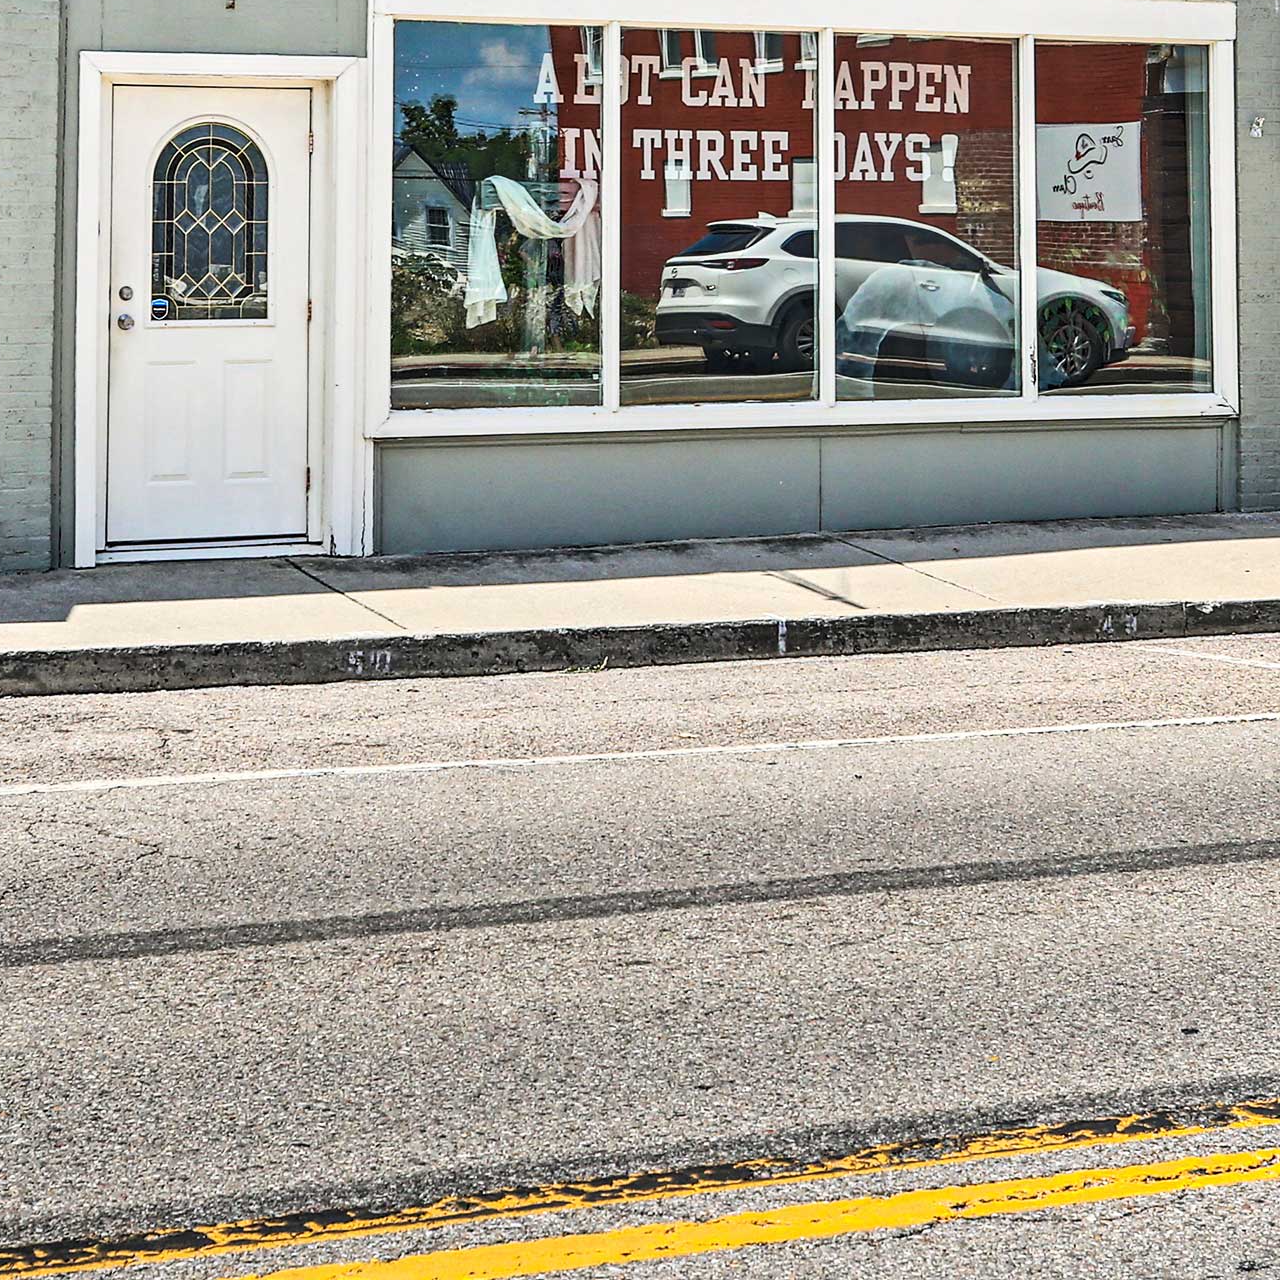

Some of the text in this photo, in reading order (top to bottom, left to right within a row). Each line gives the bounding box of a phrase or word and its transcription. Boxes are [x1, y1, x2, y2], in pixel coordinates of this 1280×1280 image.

[533, 52, 564, 104] A
[682, 57, 766, 108] CAN
[632, 128, 790, 182] THREE
